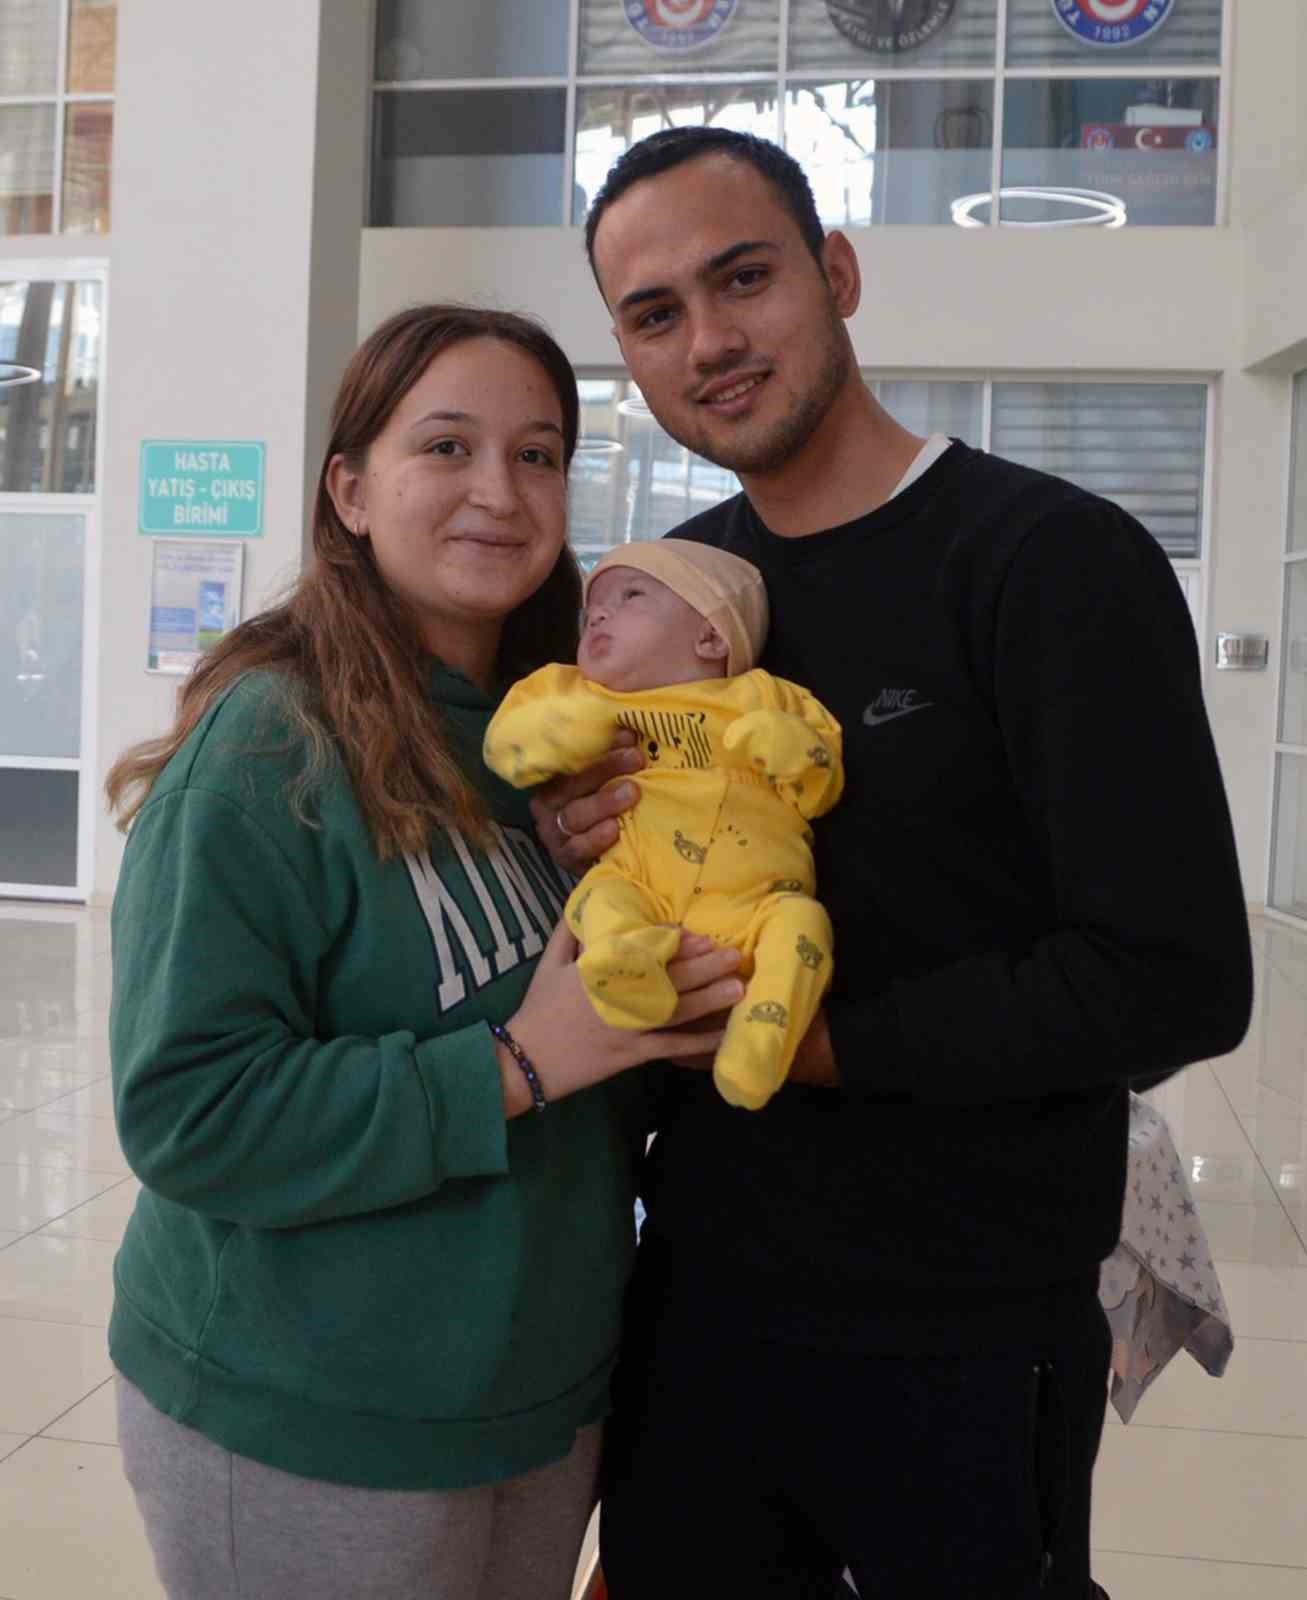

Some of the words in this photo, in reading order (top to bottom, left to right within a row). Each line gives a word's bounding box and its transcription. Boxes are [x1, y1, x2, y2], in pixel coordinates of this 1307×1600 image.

[174, 452, 232, 472] HASTA
[174, 501, 228, 525] BİRİMİ
[874, 687, 918, 709] NIKE
